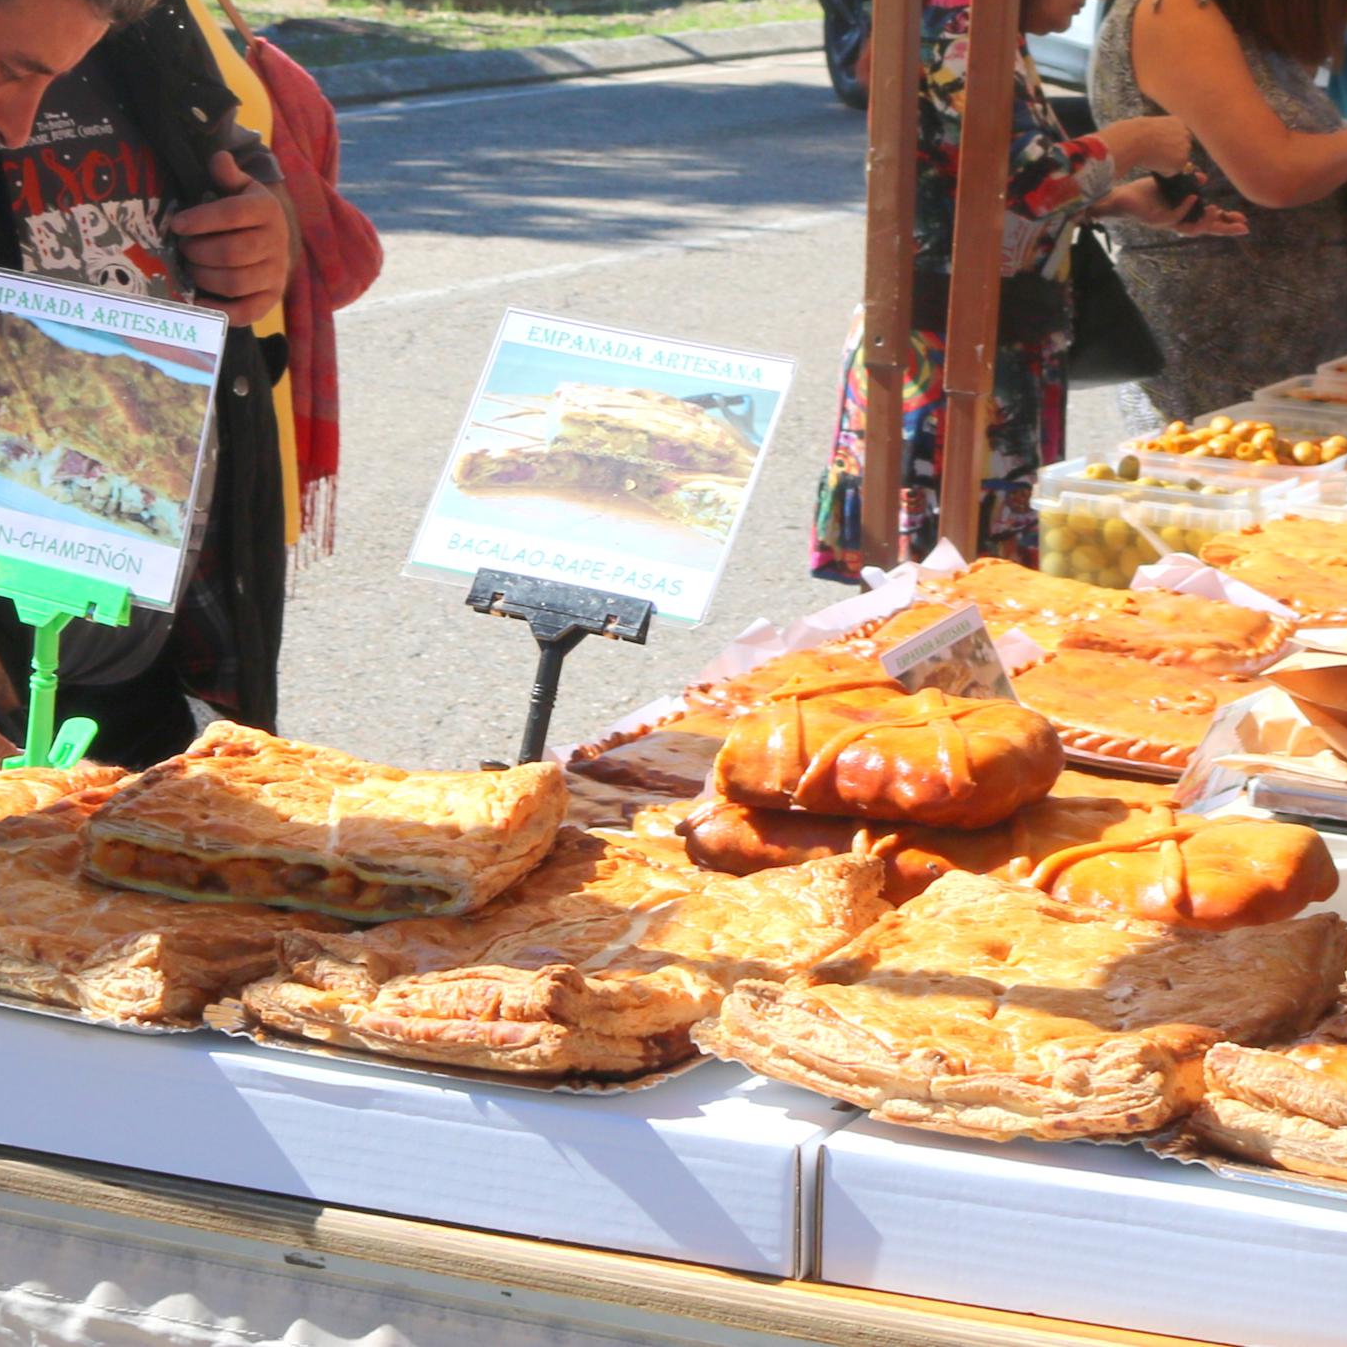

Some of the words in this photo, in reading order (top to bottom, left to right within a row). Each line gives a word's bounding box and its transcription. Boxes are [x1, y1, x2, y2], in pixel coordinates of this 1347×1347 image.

[90, 304, 198, 344] ARTESANA
[525, 324, 645, 363] EMPANADA
[649, 348, 765, 384] ARTESANA
[446, 531, 685, 598] BACALAO-RAPE-PASAS
